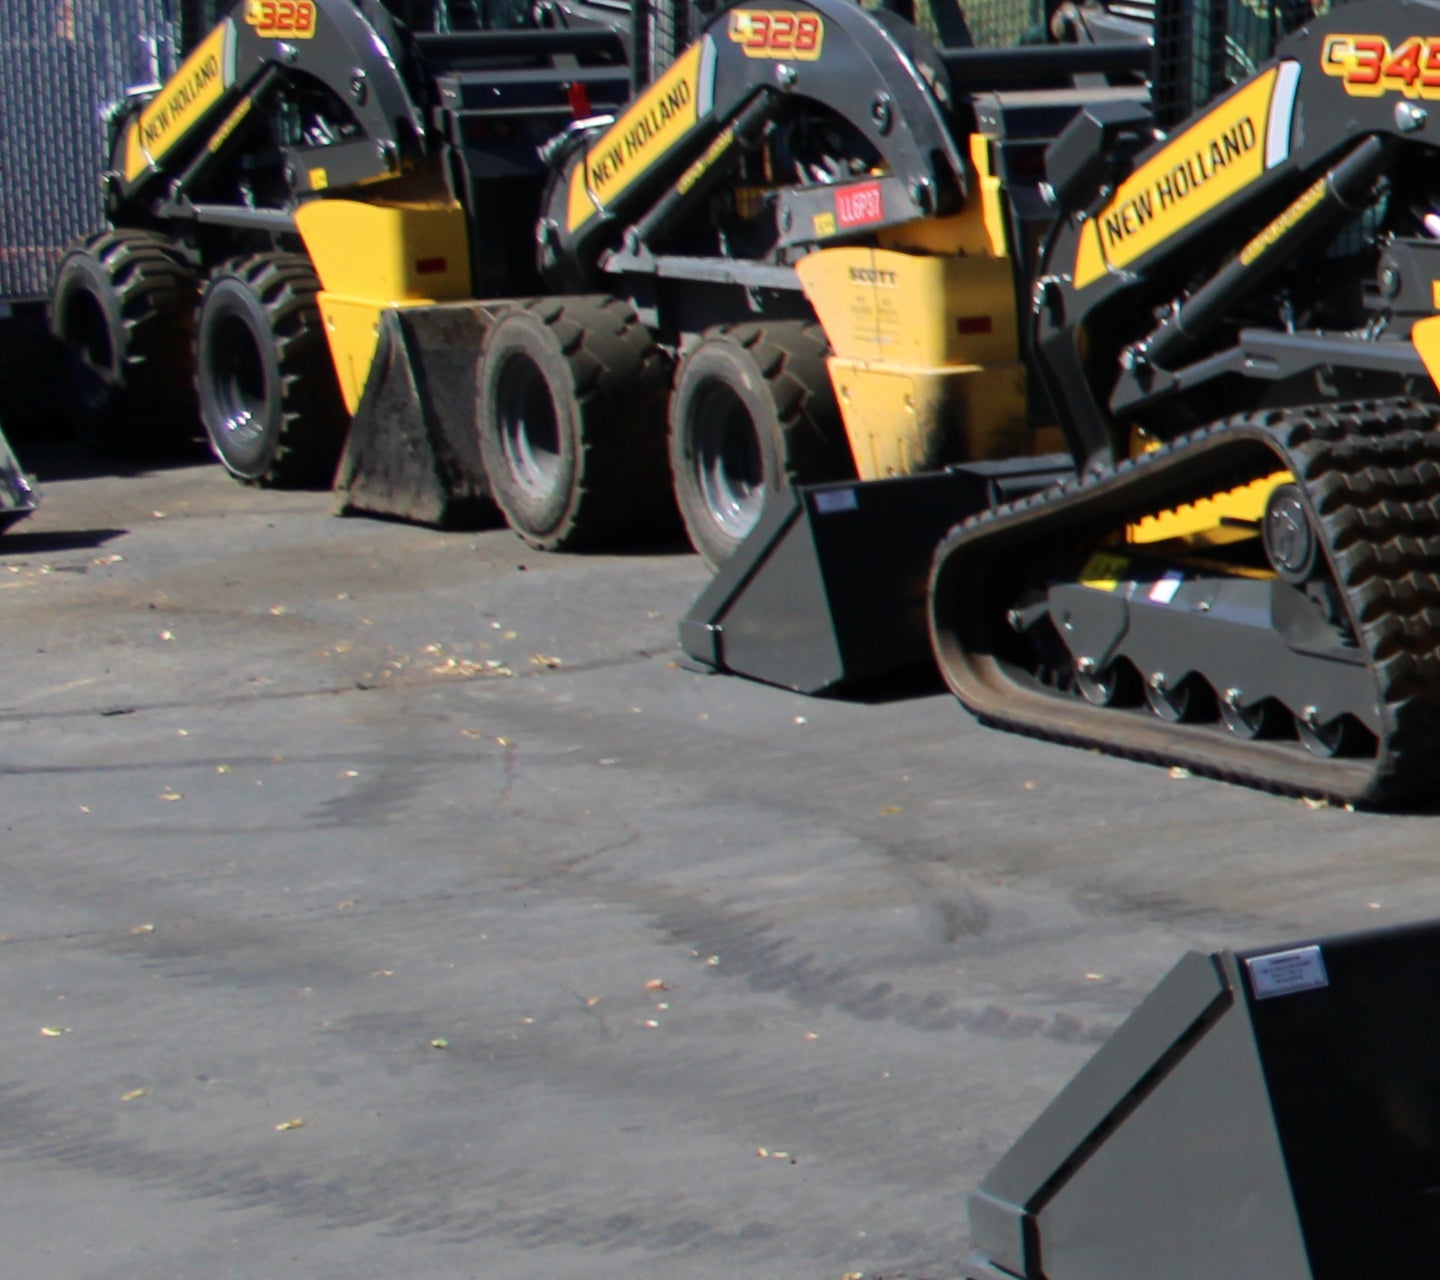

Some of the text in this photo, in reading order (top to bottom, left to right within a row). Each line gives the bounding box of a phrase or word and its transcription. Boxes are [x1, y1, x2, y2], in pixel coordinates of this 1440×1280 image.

[142, 55, 219, 145] NEW HOLLAND
[591, 145, 626, 190] NEW
[625, 79, 691, 158] HOLLAND
[1102, 188, 1154, 247] NEW
[1155, 115, 1257, 210] HOLLAND
[849, 267, 897, 286] SCOTT
